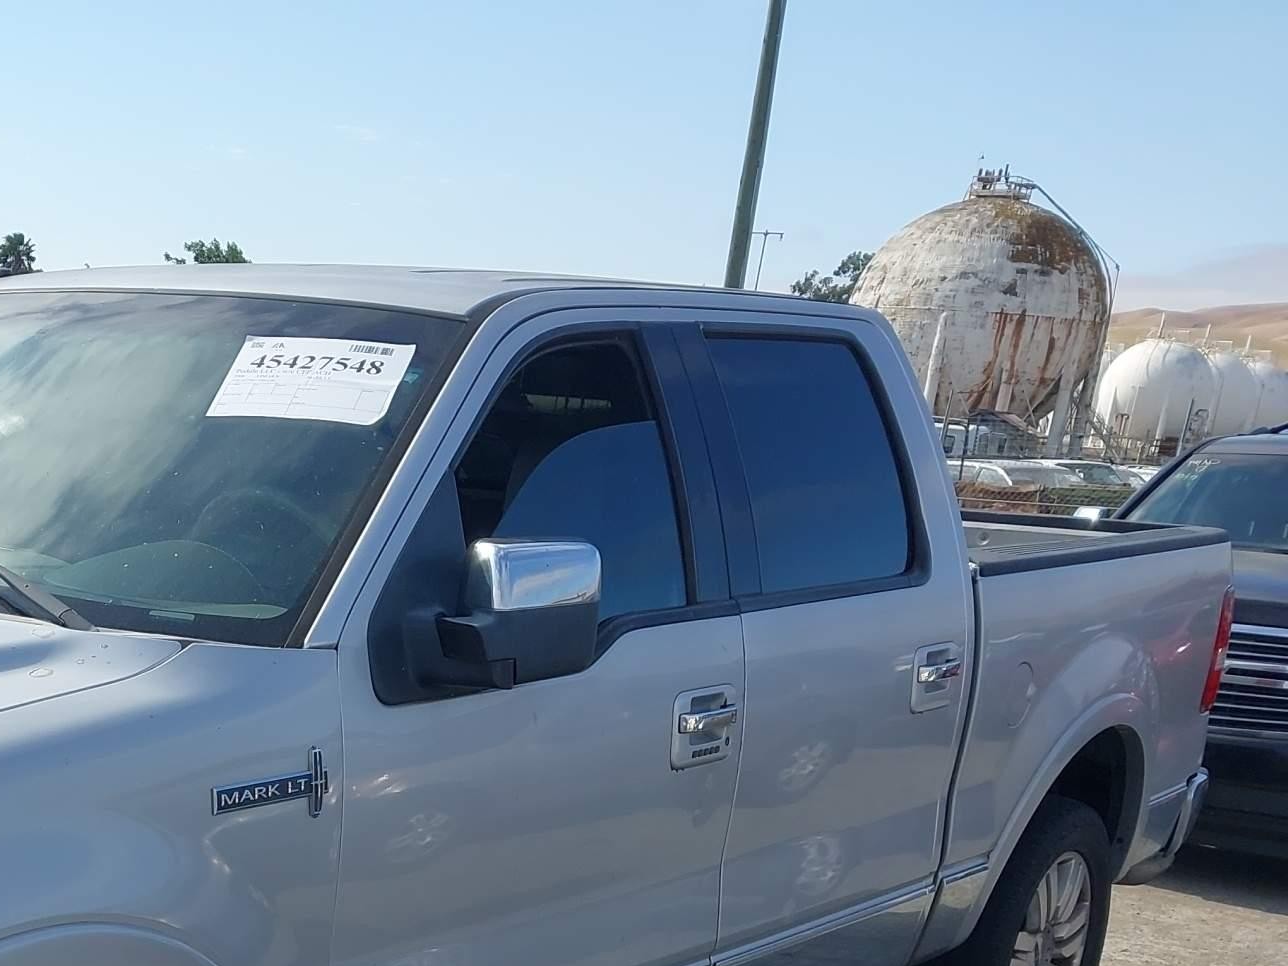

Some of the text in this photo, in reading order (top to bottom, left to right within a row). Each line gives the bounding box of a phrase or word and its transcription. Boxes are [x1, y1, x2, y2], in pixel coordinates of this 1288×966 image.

[250, 354, 385, 376] 45427548
[220, 778, 309, 808] MARK LT
